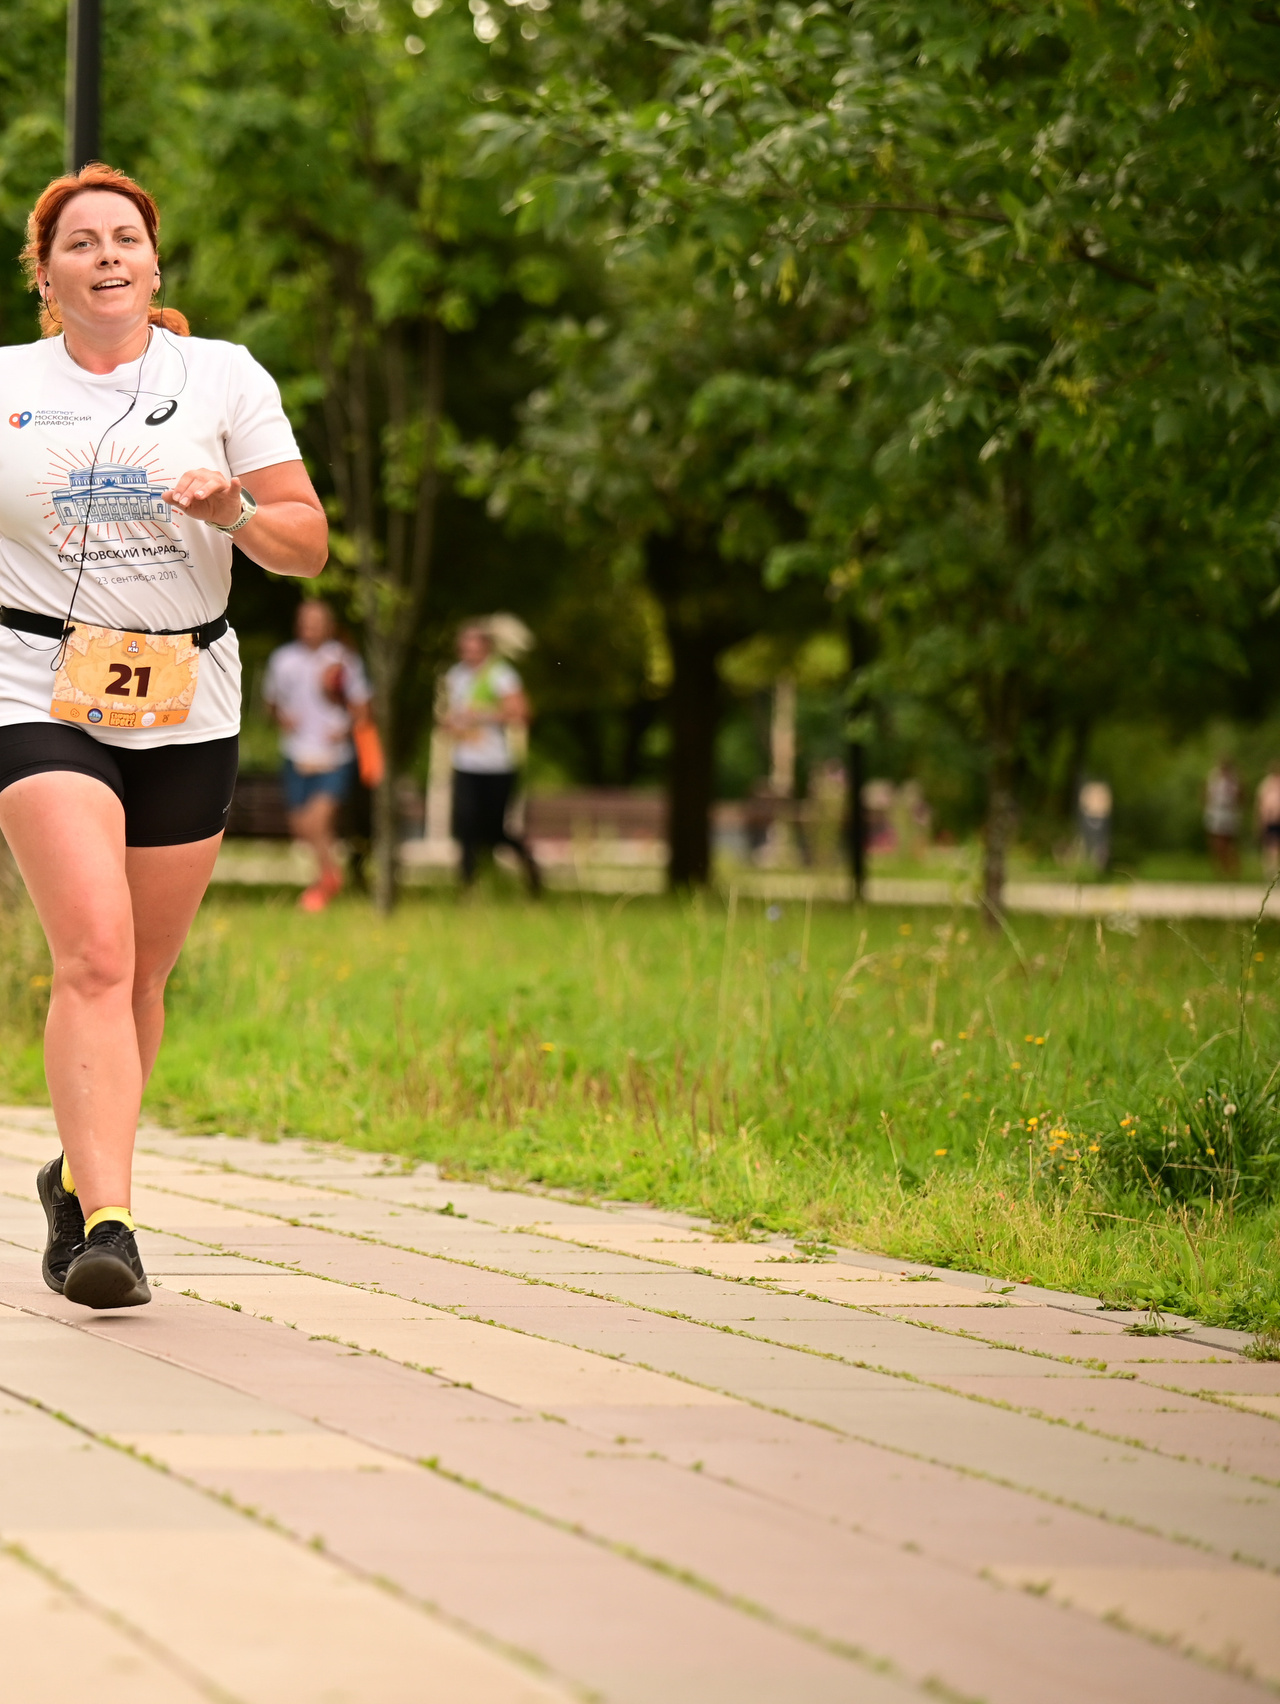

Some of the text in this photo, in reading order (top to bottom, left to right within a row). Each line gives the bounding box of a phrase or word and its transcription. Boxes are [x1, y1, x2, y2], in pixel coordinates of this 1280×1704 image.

[57, 546, 139, 563] МОСКОВСКИЙ
[95, 576, 109, 586] 23
[111, 573, 157, 585] сентября
[105, 663, 151, 697] 21
